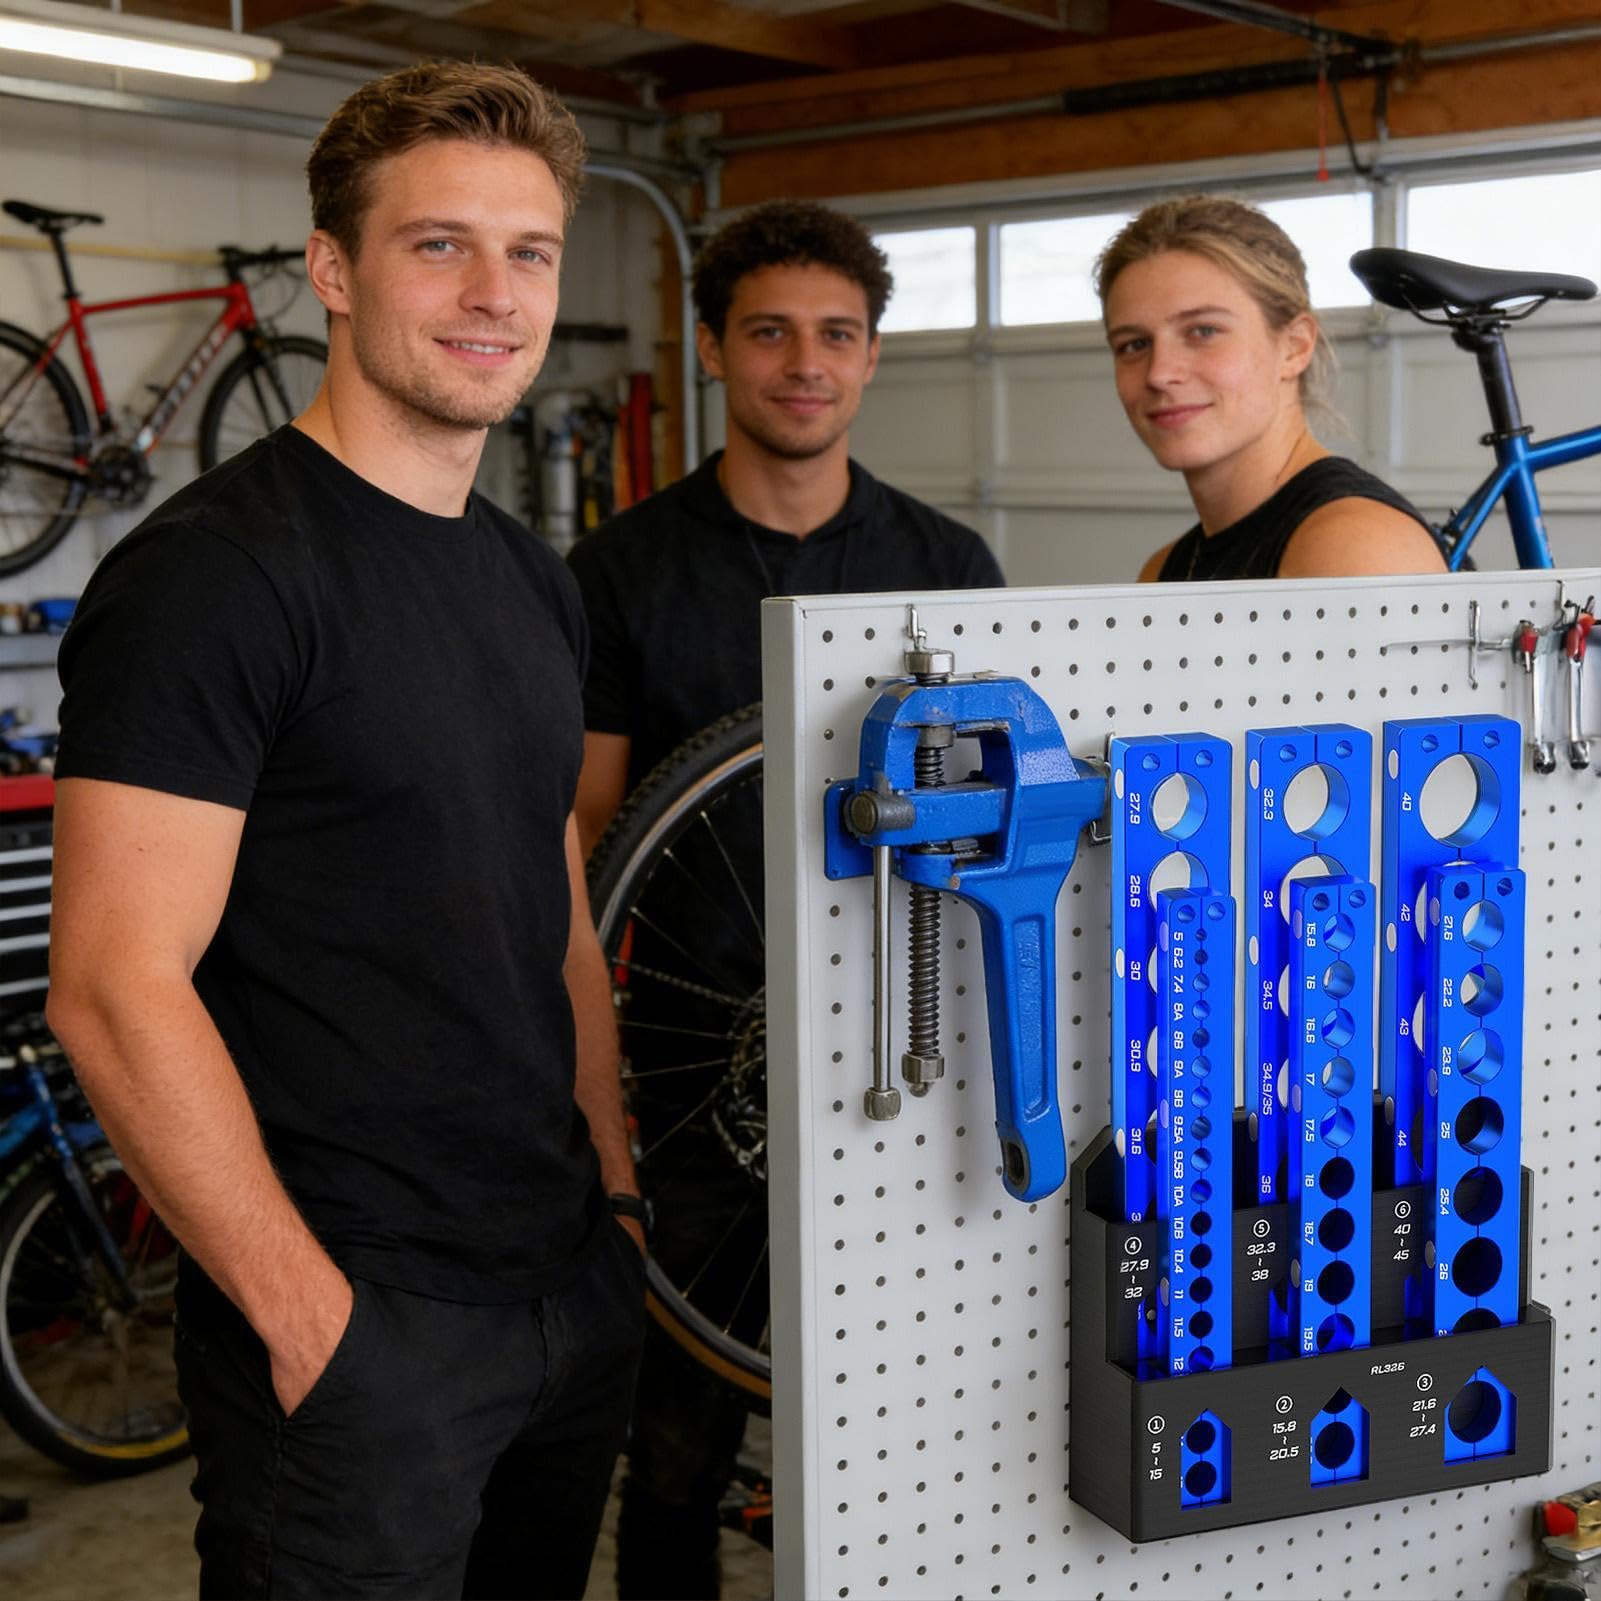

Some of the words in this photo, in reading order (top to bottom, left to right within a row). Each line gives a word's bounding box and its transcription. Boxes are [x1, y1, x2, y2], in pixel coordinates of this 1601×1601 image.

[1129, 792, 1141, 825] 27.9
[1263, 788, 1274, 821] 32.3
[1402, 792, 1412, 811] 40
[1130, 875, 1141, 908] 28.6
[1263, 890, 1274, 908] 34
[1400, 903, 1411, 922] 42
[1173, 931, 1184, 941] 5
[1306, 921, 1316, 947] 15.8
[1443, 915, 1454, 941] 21.6
[1173, 947, 1184, 969] 6.2
[1130, 960, 1141, 981] 30
[1173, 975, 1184, 994] 7.4
[1306, 975, 1316, 990] 16
[1263, 980, 1273, 1010] 34.5
[1443, 978, 1453, 1008] 22.2
[1173, 1002, 1184, 1021] 8A
[1306, 1018, 1316, 1043] 16.6
[1399, 1017, 1409, 1036] 43
[1173, 1030, 1184, 1050] 8B
[1130, 1039, 1141, 1072] 30.9
[1442, 1046, 1452, 1076] 23.9
[1174, 1060, 1184, 1079] 9A
[1262, 1062, 1273, 1115] 34.9/35
[1305, 1073, 1315, 1086] 17
[1173, 1089, 1184, 1108] 9B
[1173, 1115, 1184, 1144] 9.5A
[1305, 1119, 1315, 1142] 17.5
[1397, 1130, 1407, 1147] 44
[1441, 1121, 1451, 1139] 25
[1131, 1128, 1142, 1155] 31.6
[1173, 1150, 1184, 1179] 9.5B
[1261, 1175, 1271, 1194] 36
[1305, 1174, 1315, 1187] 18
[1173, 1185, 1184, 1207] 10A
[1440, 1188, 1450, 1216] 25.4
[1173, 1216, 1184, 1240] 10B
[1304, 1221, 1314, 1246] 18.7
[1393, 1223, 1411, 1235] 40
[1246, 1241, 1276, 1256] 32.3
[1393, 1249, 1410, 1261] 45
[1119, 1259, 1150, 1273] 27.9
[1174, 1248, 1184, 1274] 10.4
[1251, 1269, 1269, 1281] 38
[1439, 1263, 1449, 1280] 26
[1124, 1286, 1143, 1299] 32
[1174, 1289, 1184, 1299] 11
[1304, 1278, 1314, 1292] 19
[1174, 1317, 1184, 1338] 11.5
[1303, 1326, 1313, 1351] 19.5
[1173, 1357, 1184, 1371] 12
[1370, 1361, 1406, 1376] RL326
[1412, 1398, 1437, 1412] 21.6
[1272, 1420, 1297, 1434] 15.8
[1409, 1423, 1436, 1438] 27.4
[1151, 1441, 1162, 1454] 5
[1269, 1445, 1300, 1461] 20.5
[1149, 1468, 1163, 1481] 15
